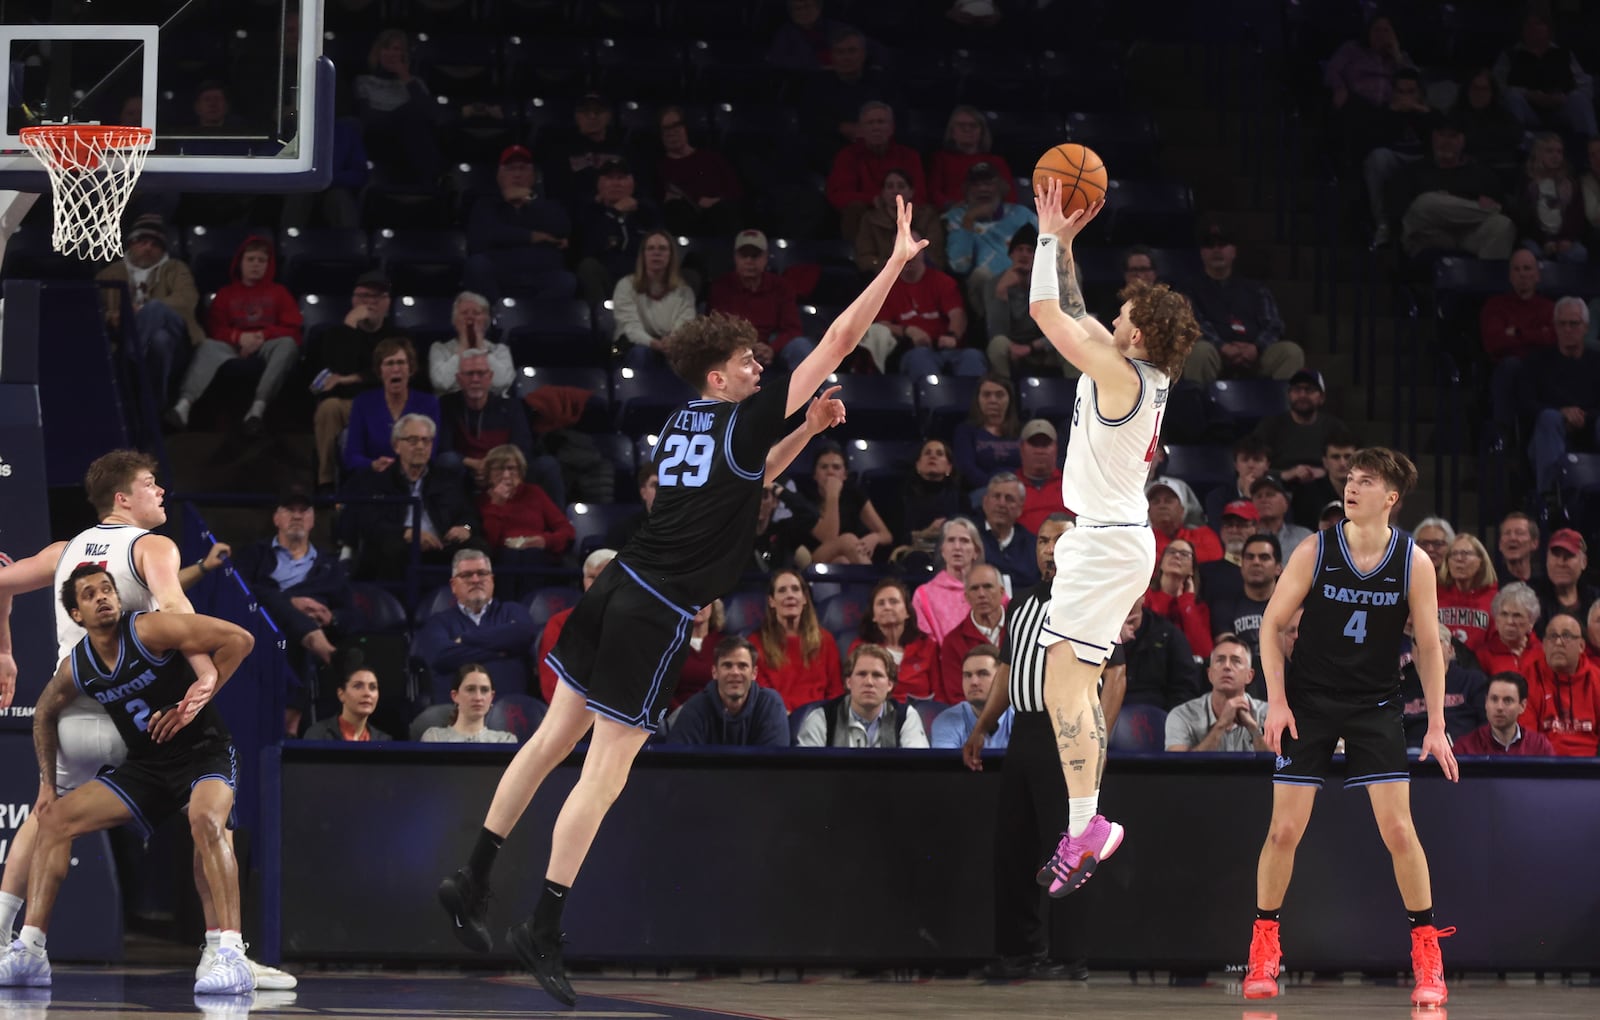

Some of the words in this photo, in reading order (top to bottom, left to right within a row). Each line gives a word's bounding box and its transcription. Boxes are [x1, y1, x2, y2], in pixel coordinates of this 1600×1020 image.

[657, 433, 716, 487] 29
[85, 543, 110, 556] WALZ
[1323, 583, 1400, 606] DAYTON
[1343, 609, 1368, 644] 4
[94, 668, 158, 704] DAYTON
[125, 697, 151, 732] 2
